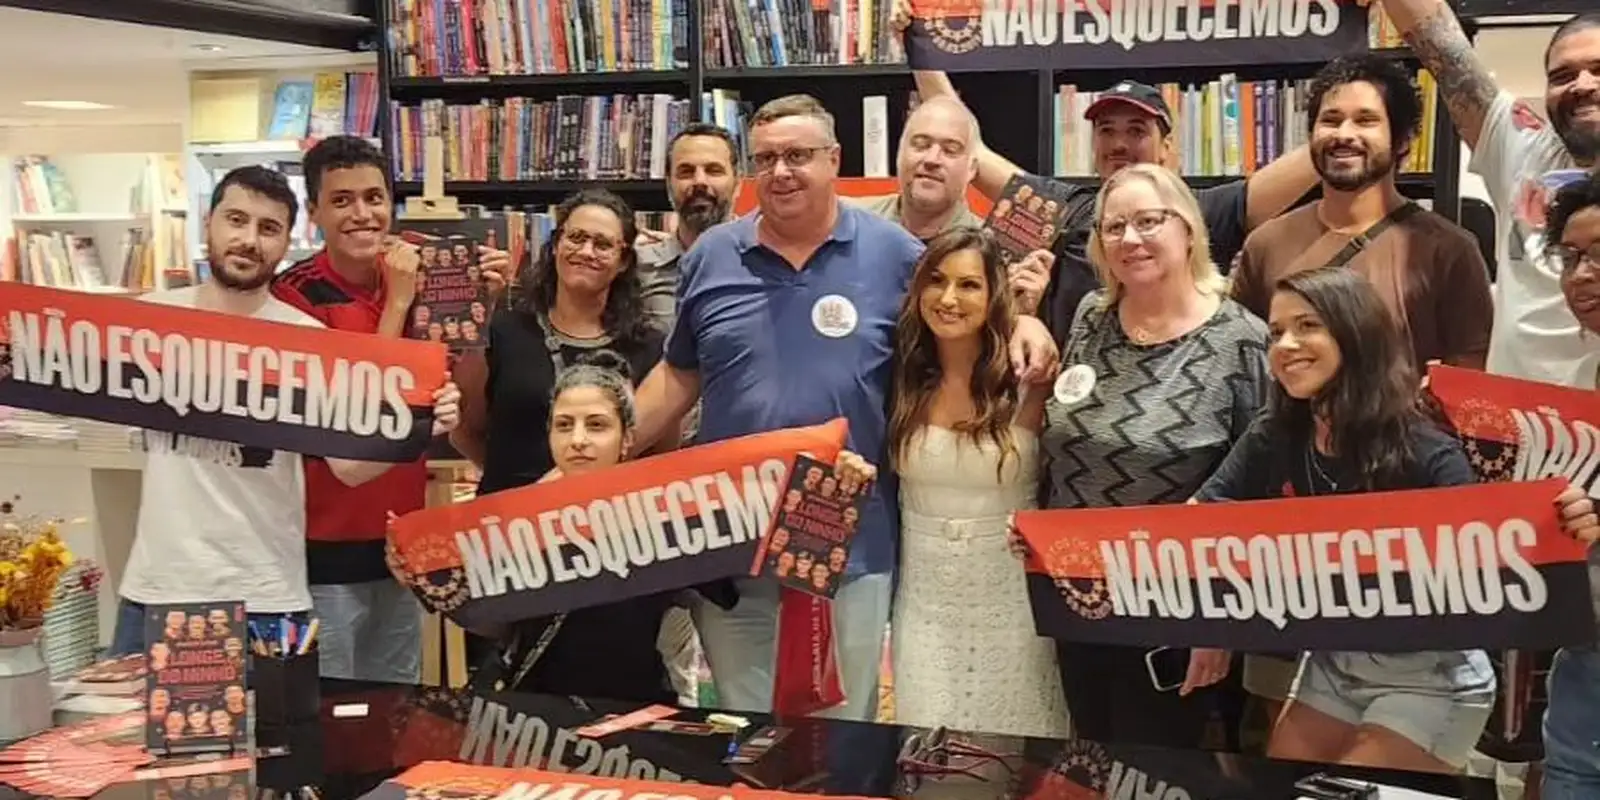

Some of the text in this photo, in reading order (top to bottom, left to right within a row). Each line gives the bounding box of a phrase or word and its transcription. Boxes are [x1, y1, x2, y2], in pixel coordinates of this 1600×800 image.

[1063, 0, 1340, 51] ESQUECEMOS
[9, 307, 416, 440] NÃO ESQUECEMOS
[455, 515, 549, 599] NÃO
[538, 459, 788, 582] ESQUECEMO
[1099, 529, 1195, 619] NÃO
[1194, 518, 1548, 630] ESQUECEMOS
